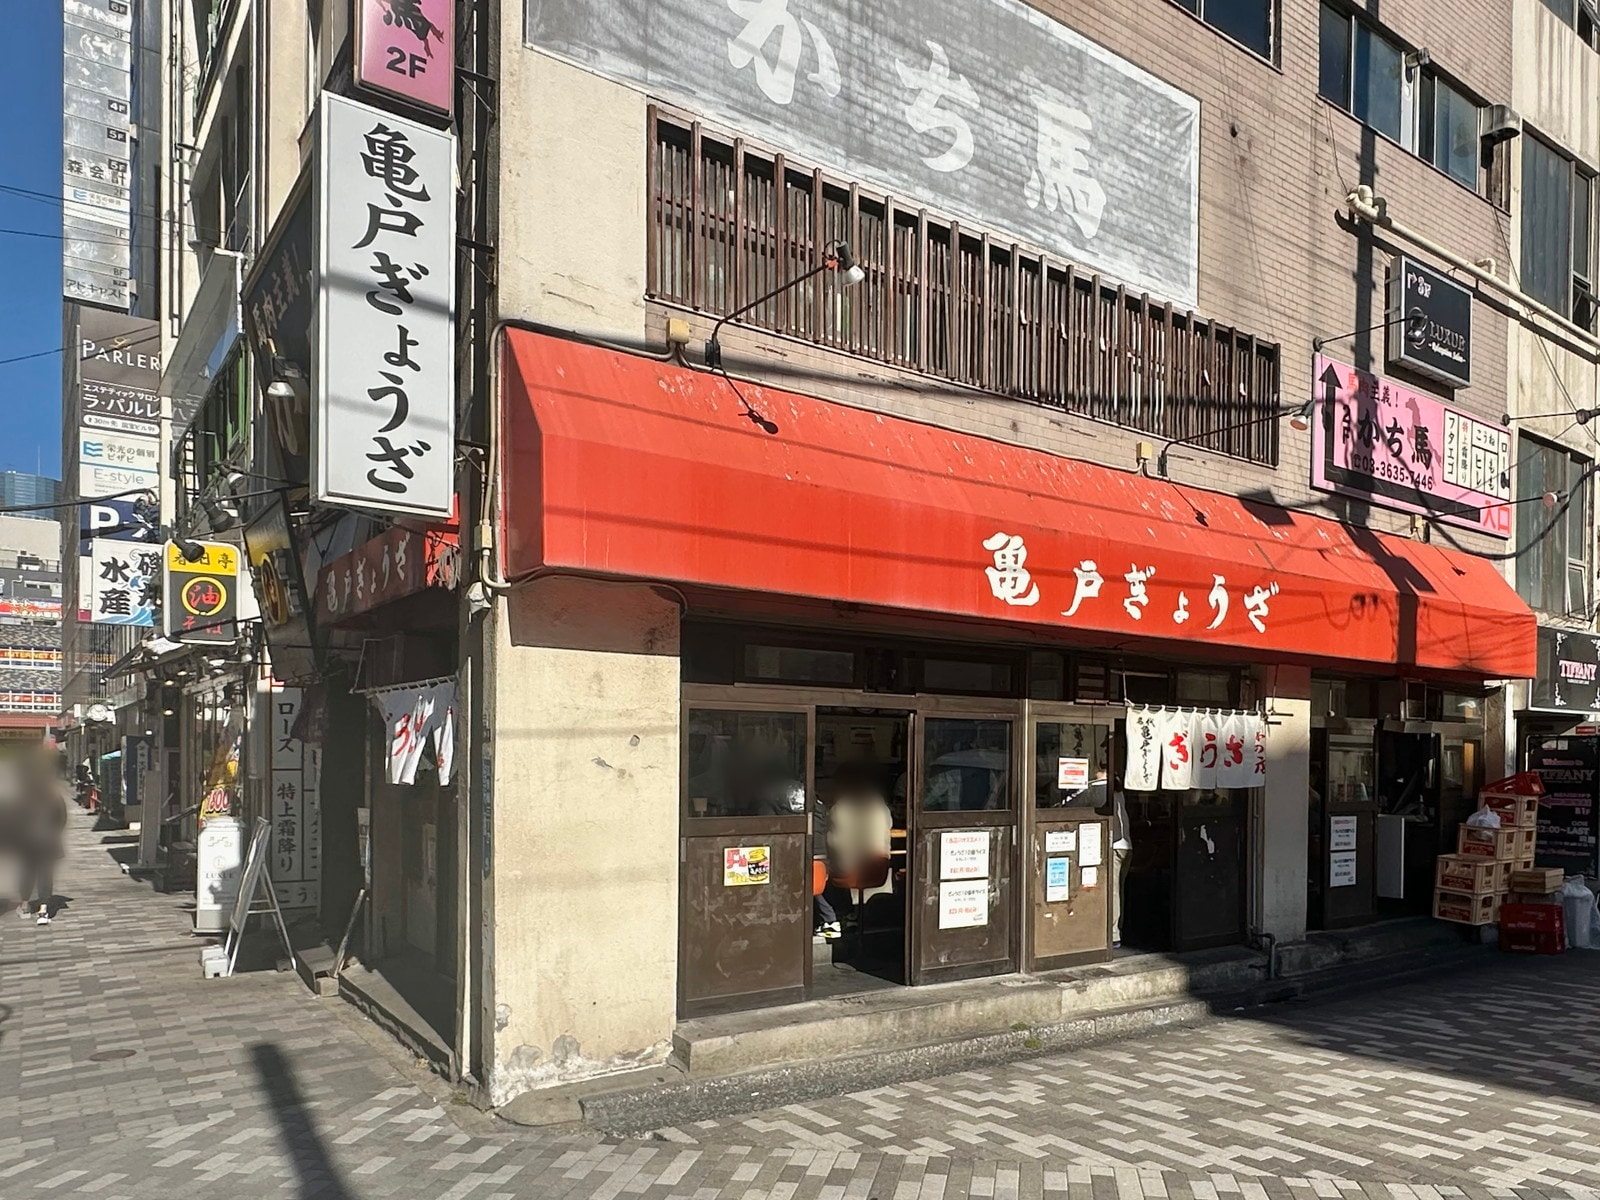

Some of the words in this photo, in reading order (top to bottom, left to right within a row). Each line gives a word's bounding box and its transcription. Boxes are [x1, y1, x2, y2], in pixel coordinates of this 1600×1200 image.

[386, 46, 427, 78] 2F
[67, 159, 126, 186] 森会計
[351, 122, 432, 493] 亀戸ぎょうざ
[83, 339, 160, 370] PARLER
[83, 393, 160, 417] ラ・パルレ
[1358, 408, 1432, 470] かち馬
[1447, 417, 1455, 475] フタエゴ
[94, 468, 144, 485] E-style
[1483, 500, 1510, 534] 入口
[100, 557, 131, 615] 水産
[326, 531, 410, 614] 亀戸ぎょうざ
[982, 532, 1279, 633] 亀戸ぎょうざ
[188, 584, 221, 608] 油
[1559, 659, 1597, 681] TIFFANY
[279, 702, 295, 752] ロース
[277, 782, 296, 872] 特上霜降り
